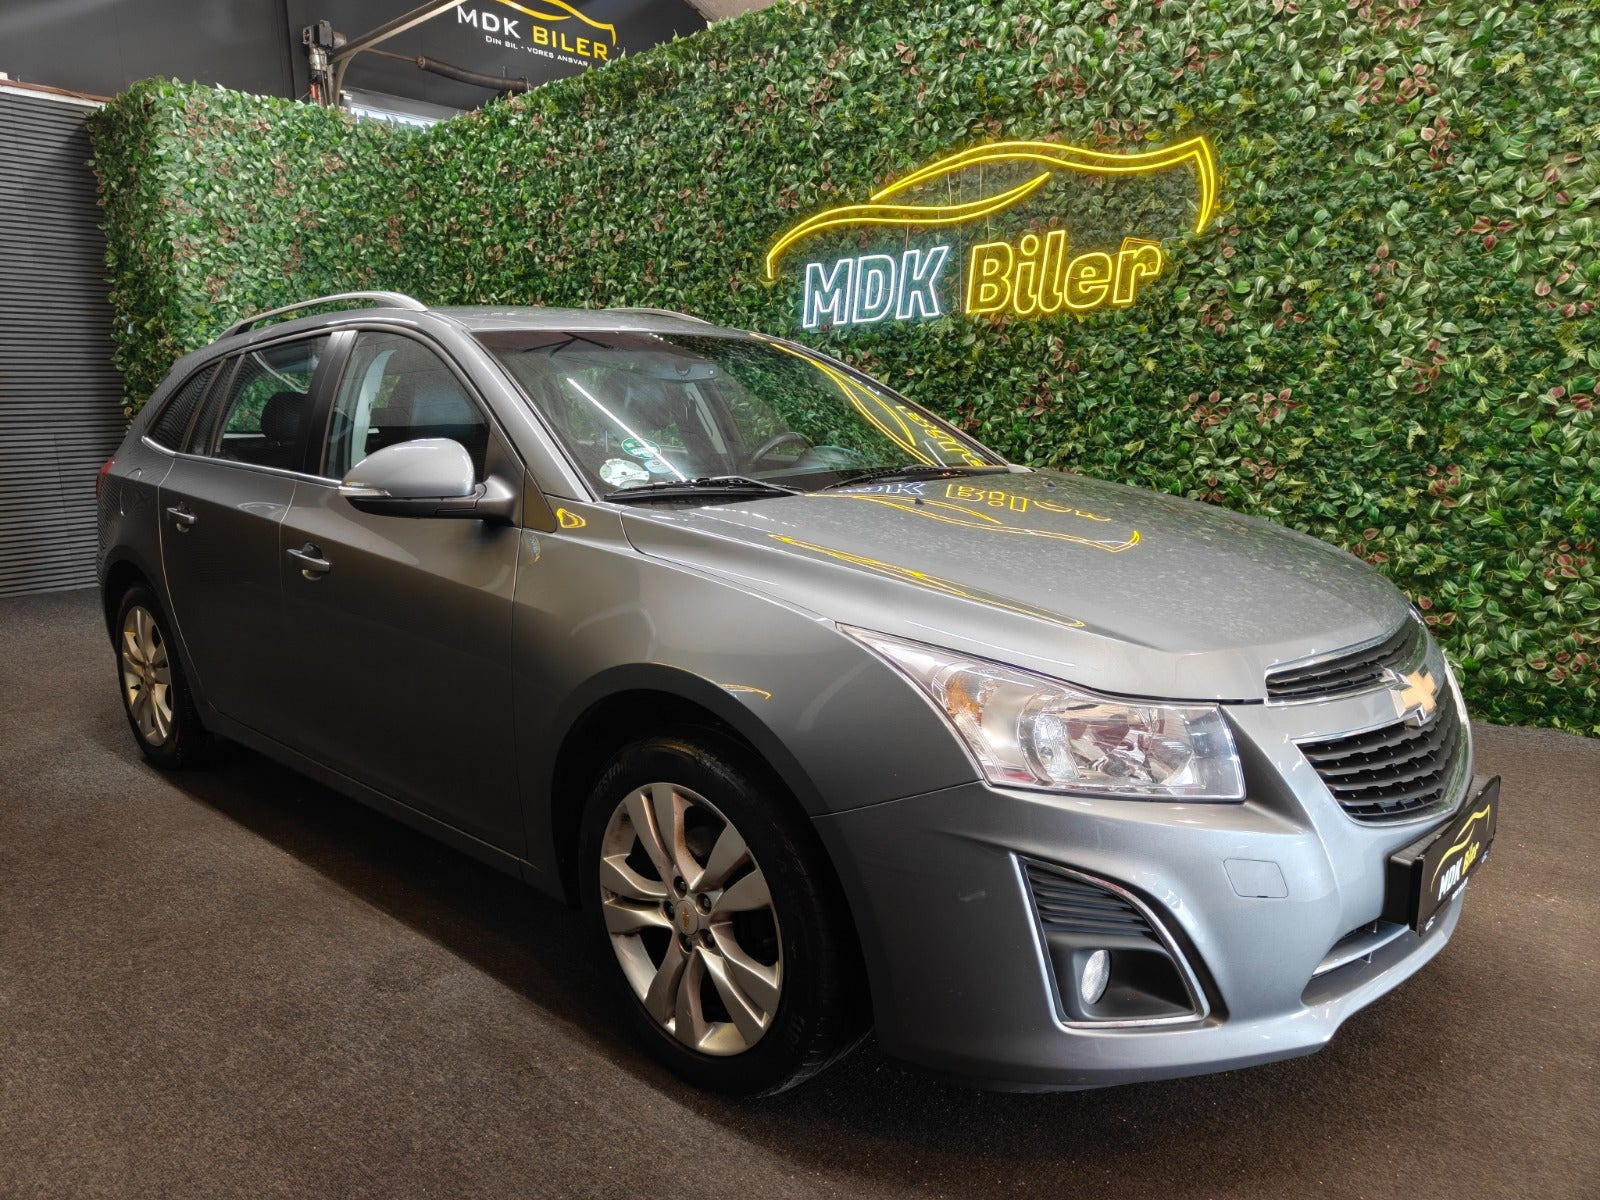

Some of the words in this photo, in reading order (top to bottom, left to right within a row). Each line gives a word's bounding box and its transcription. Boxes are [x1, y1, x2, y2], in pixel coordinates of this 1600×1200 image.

[457, 5, 521, 39] MDK
[532, 25, 608, 62] BILER
[485, 35, 502, 46] DIN
[504, 40, 518, 50] BIL
[526, 46, 554, 59] VORES
[802, 246, 950, 328] MDK
[966, 230, 1164, 315] Biler
[1437, 857, 1463, 901] MDK
